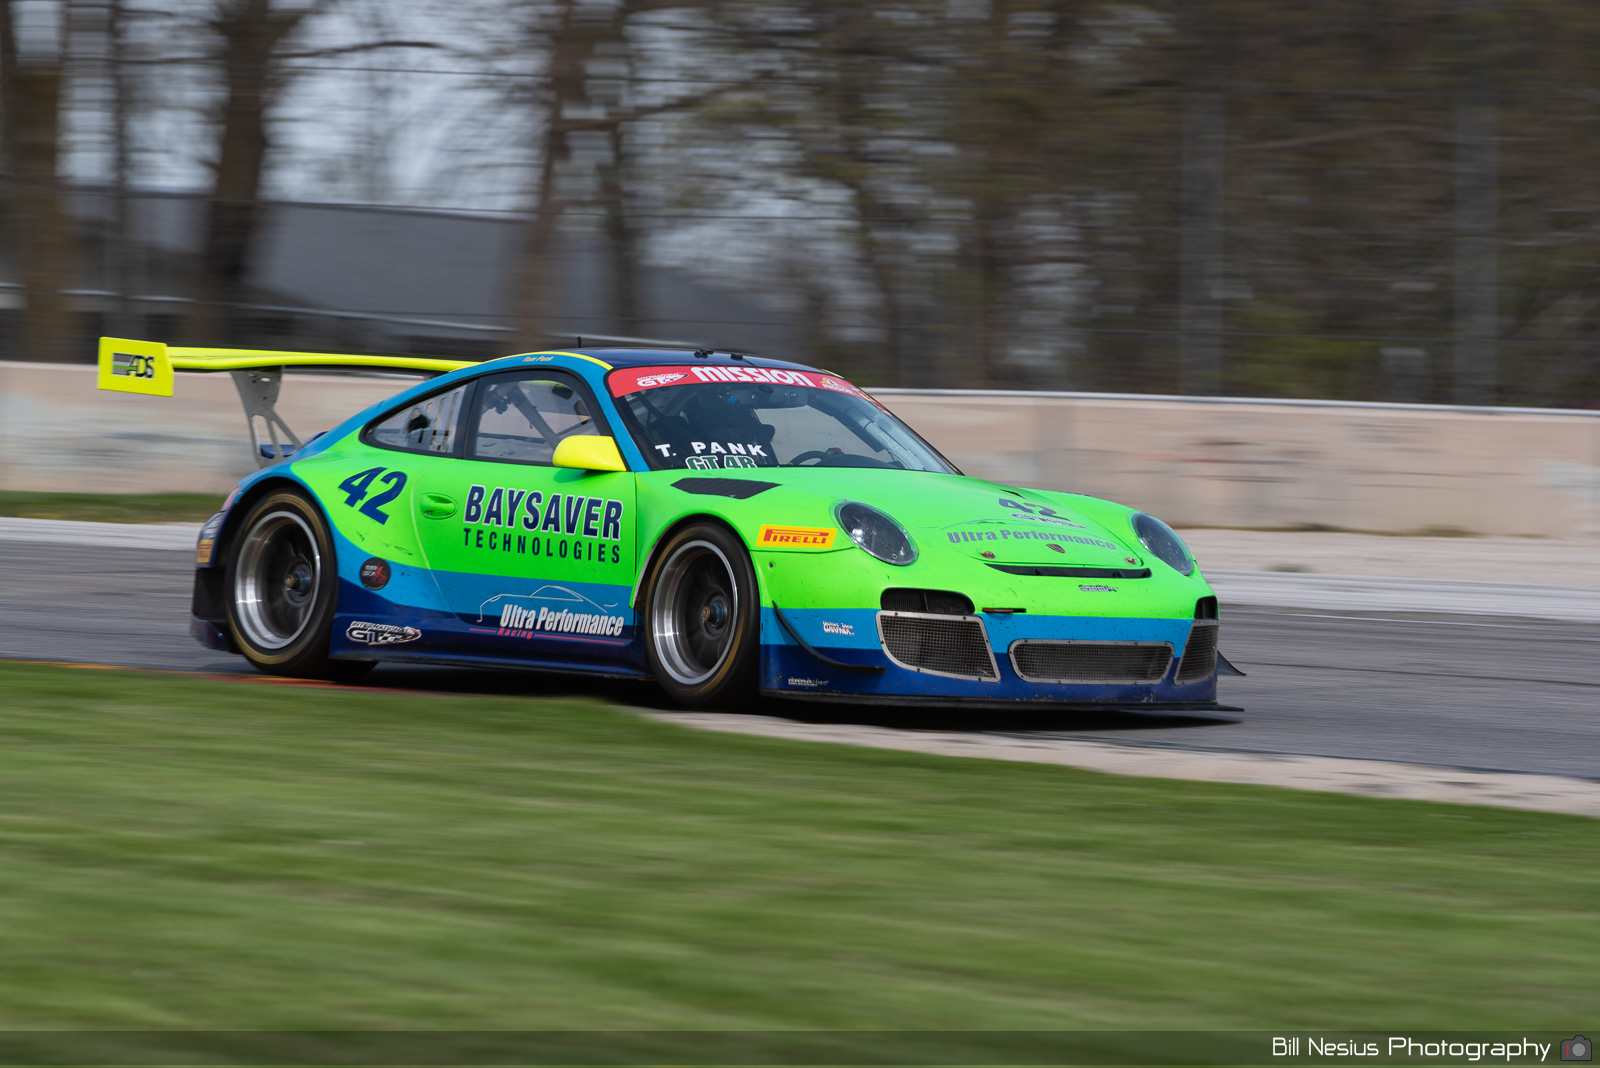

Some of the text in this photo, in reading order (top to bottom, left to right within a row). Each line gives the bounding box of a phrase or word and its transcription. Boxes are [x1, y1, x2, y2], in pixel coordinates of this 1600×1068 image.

[127, 355, 156, 379] ADS
[690, 366, 816, 387] MISSION
[654, 441, 768, 458] T. PANK
[685, 455, 721, 471] GT
[337, 466, 409, 525] 42
[463, 484, 624, 541] BAYSAVER
[998, 498, 1071, 521] 42
[463, 527, 621, 564] TECHNOLOGIES
[763, 528, 829, 544] PIRELLI
[947, 529, 1117, 550] Ultra Performance
[500, 603, 625, 637] Ultra Performance
[497, 627, 534, 640] Racing
